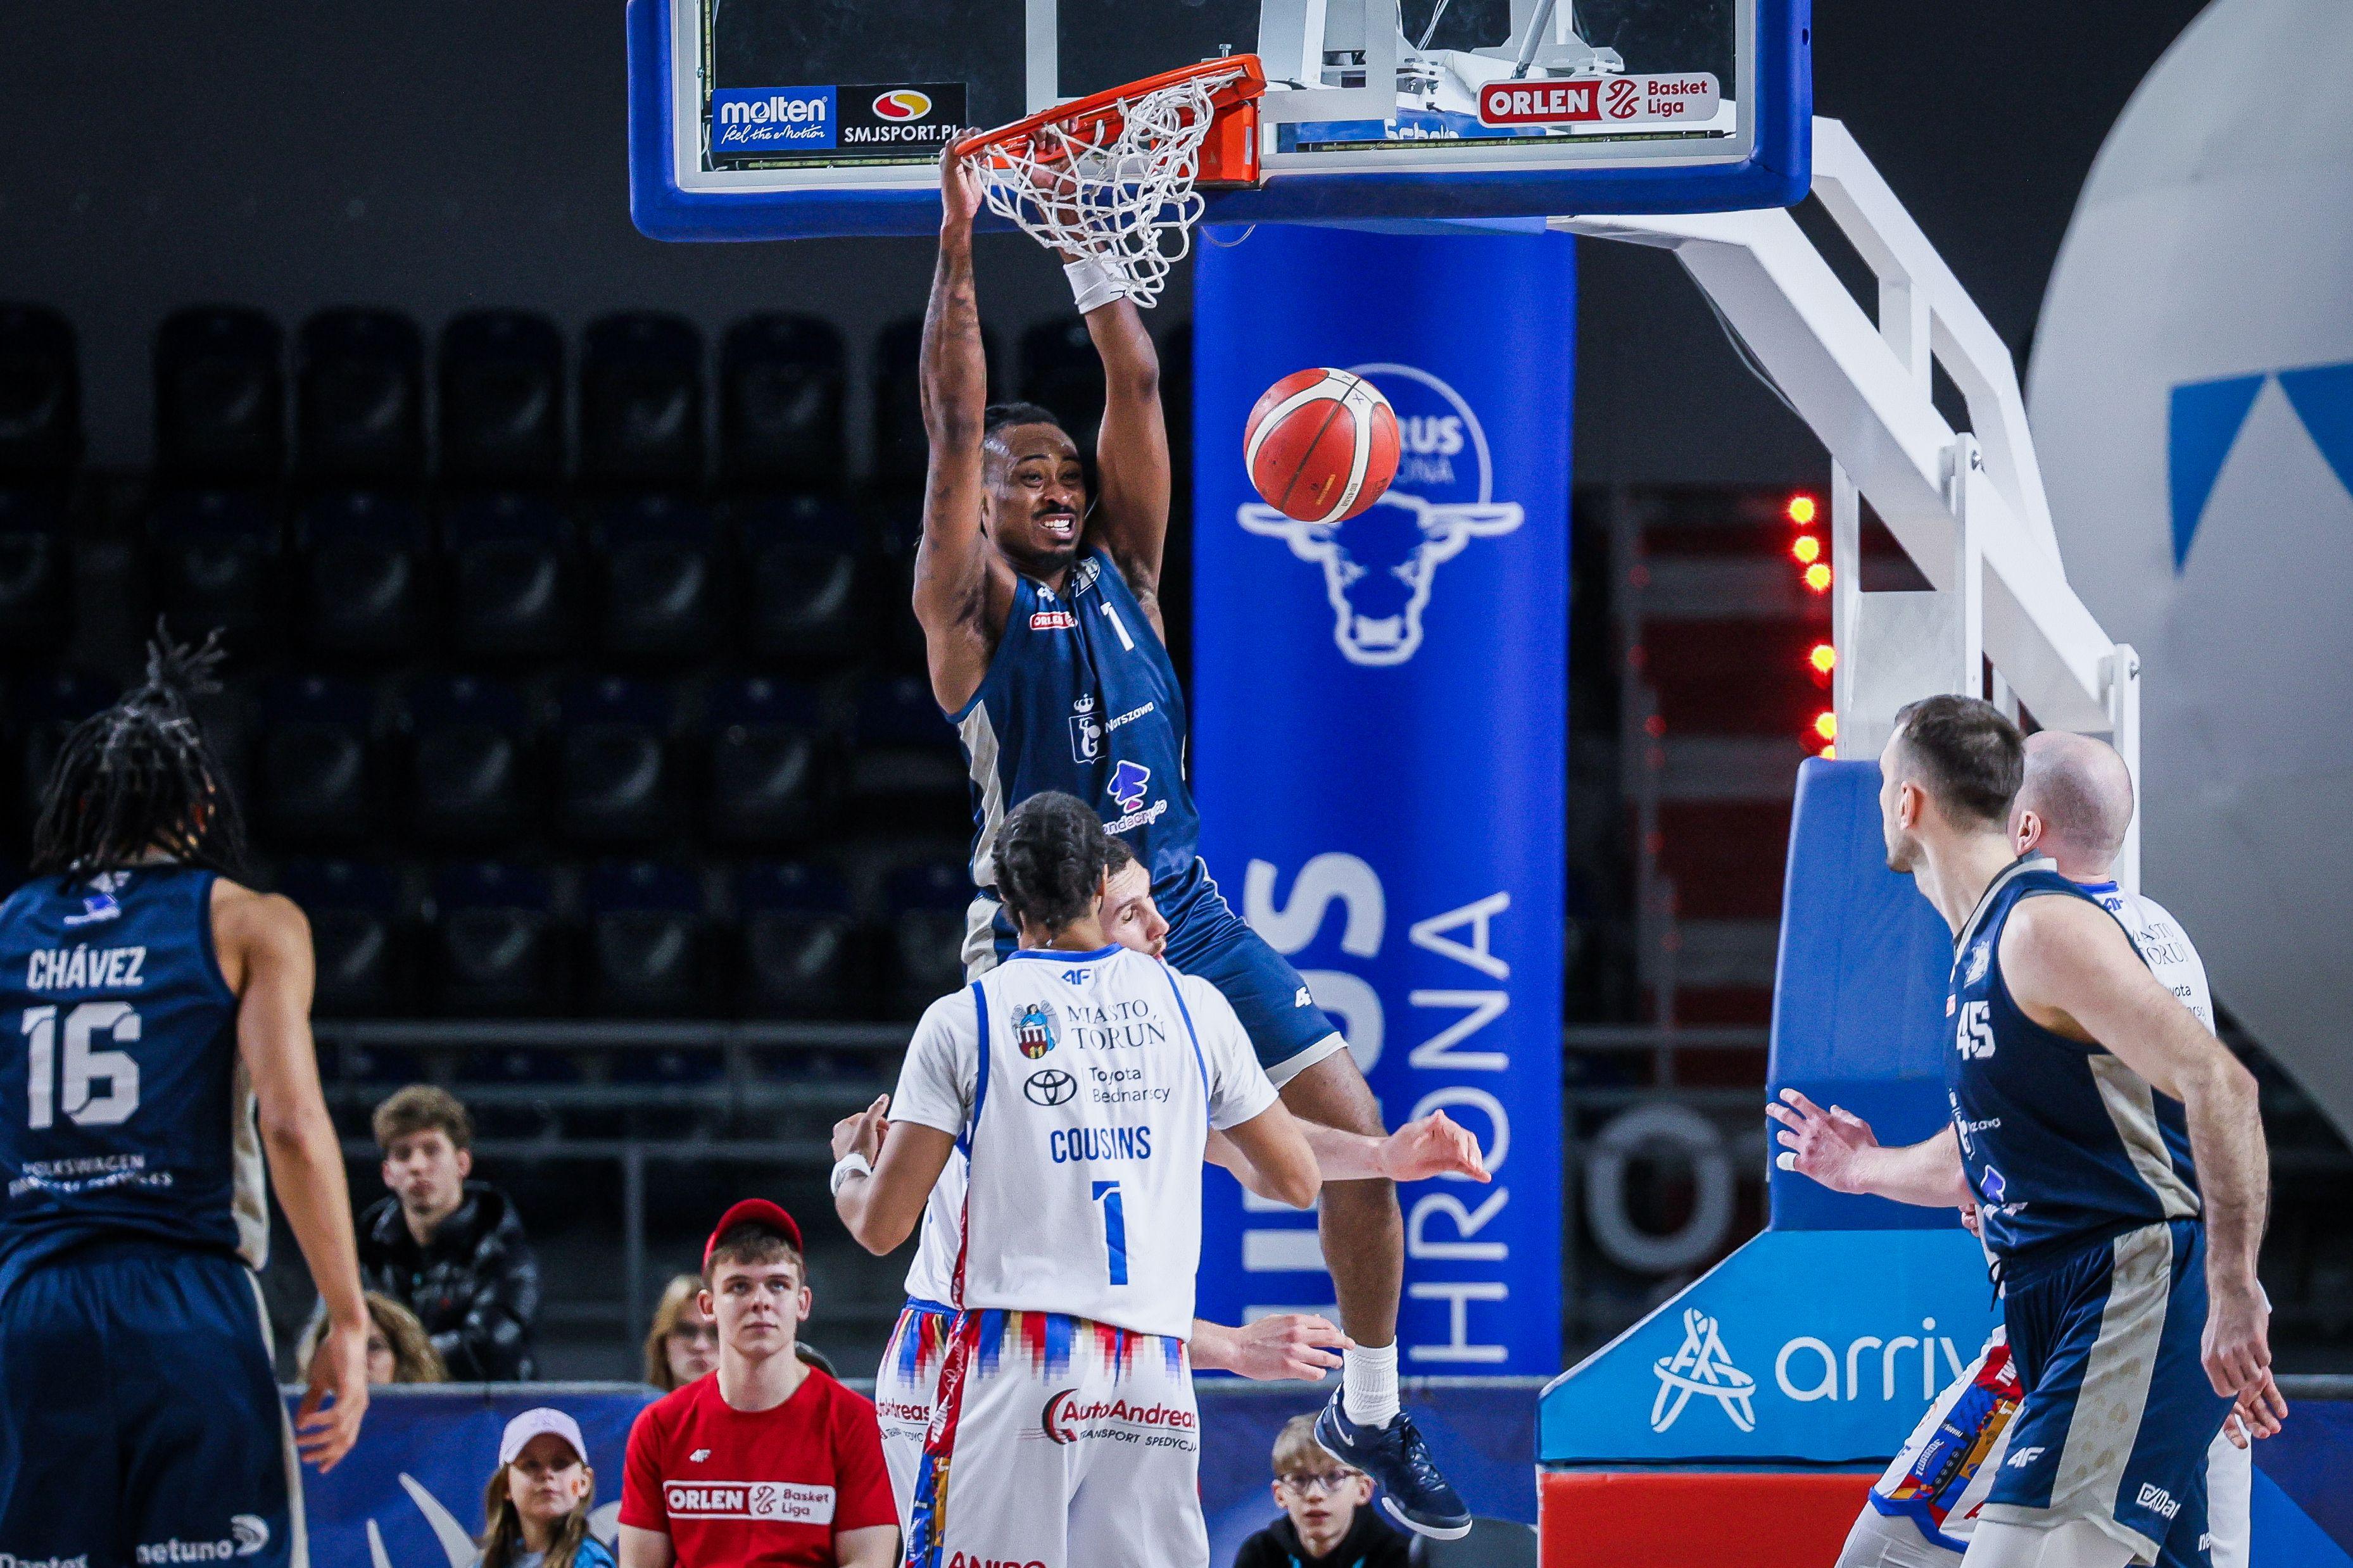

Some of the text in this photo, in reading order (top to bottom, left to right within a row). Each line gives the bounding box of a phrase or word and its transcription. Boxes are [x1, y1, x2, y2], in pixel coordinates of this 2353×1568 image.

[1648, 79, 1708, 96] Basket
[721, 96, 825, 123] molten
[1489, 89, 1589, 115] ORLEN
[1648, 98, 1684, 118] Liga
[721, 124, 752, 144] feel
[750, 127, 773, 140] the
[1101, 601, 1135, 651] 1
[27, 943, 146, 990] CHÁVEZ
[1066, 999, 1149, 1024] MIASTO
[1071, 1015, 1166, 1050] TORUŃ
[1956, 1000, 1996, 1060] 45
[22, 1001, 141, 1129] 16
[1088, 1067, 1142, 1085] Toyota
[1050, 1126, 1152, 1163] COUSINS
[1092, 1181, 1128, 1285] 1
[1775, 1317, 1993, 1402] arriv
[668, 1489, 744, 1510] ORLEN
[783, 1488, 830, 1503] Basket
[782, 1503, 811, 1517] Liga
[136, 1538, 234, 1564] netuno
